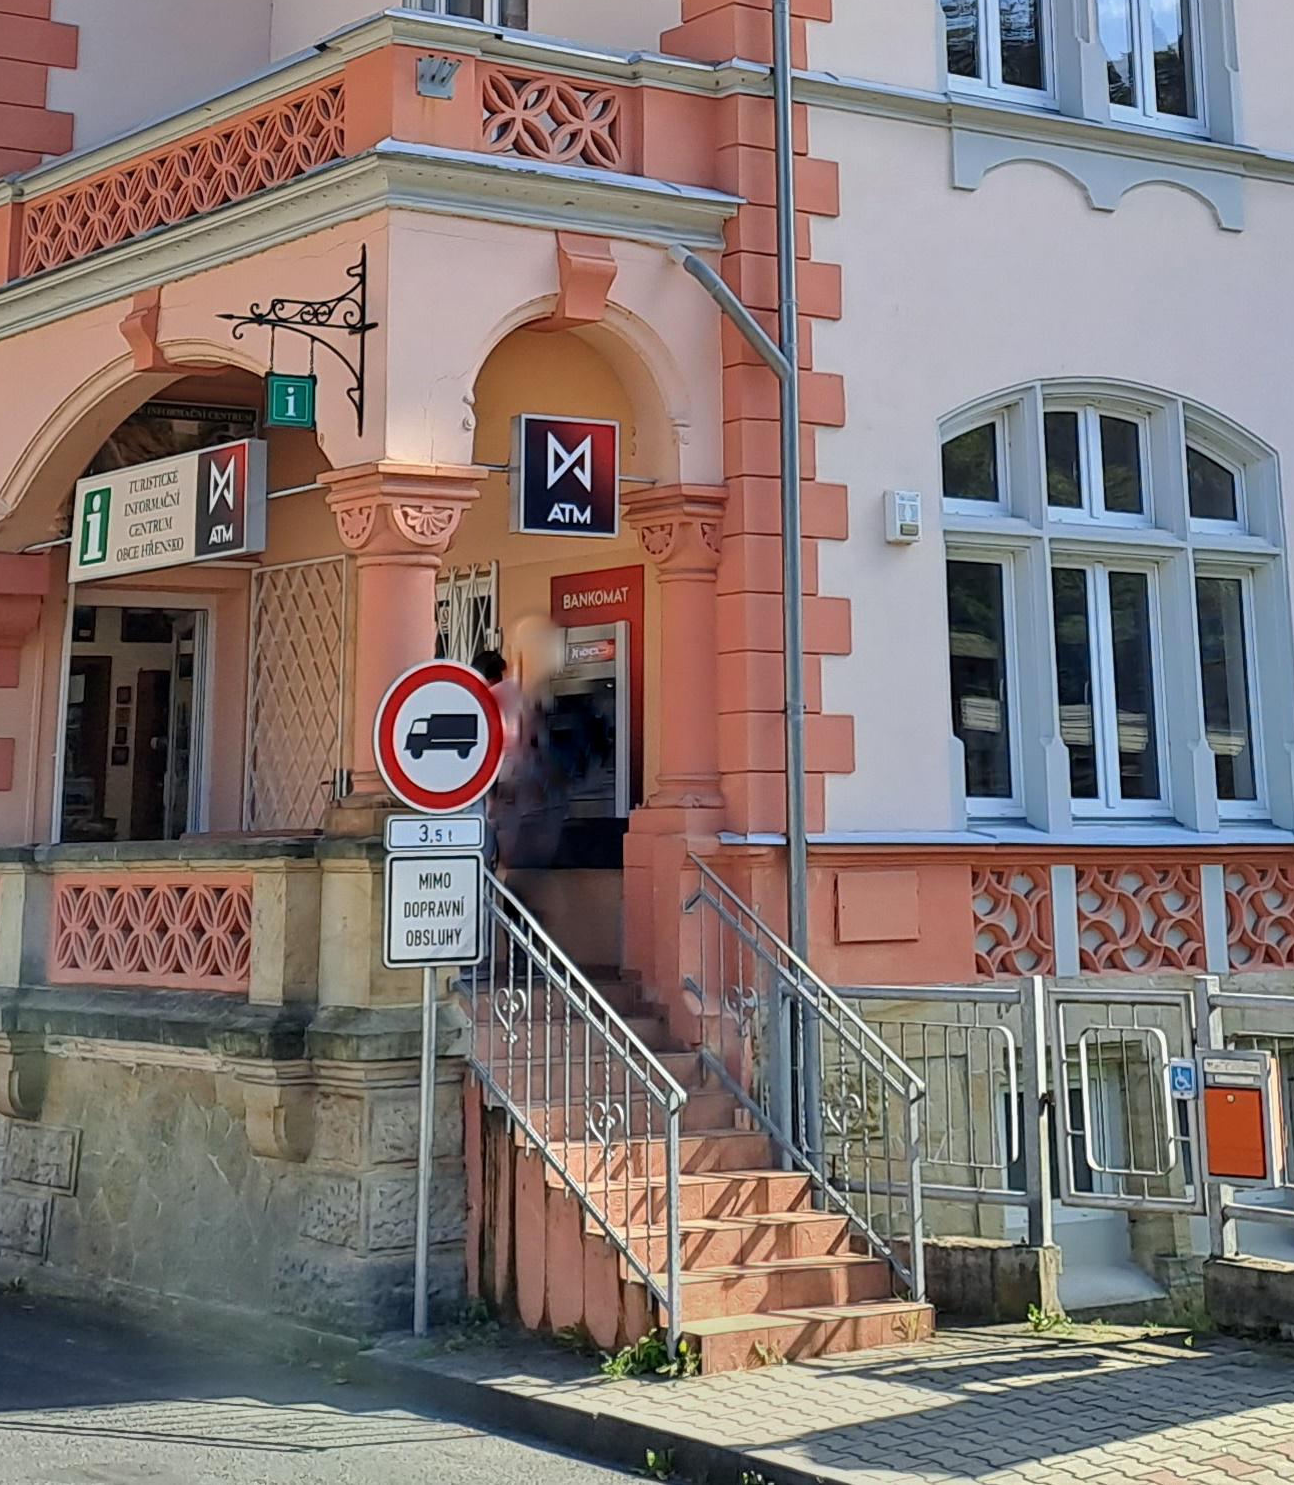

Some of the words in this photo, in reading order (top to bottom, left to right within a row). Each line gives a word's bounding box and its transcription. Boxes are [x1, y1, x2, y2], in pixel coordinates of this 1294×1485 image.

[284, 386, 297, 417] i
[128, 467, 179, 494] TURISTICKÉ
[124, 489, 181, 516] INFORMAČNÍ
[547, 502, 591, 524] ATM
[82, 494, 103, 562] i
[128, 517, 173, 537] CENTRUM
[208, 523, 234, 545] ATM
[116, 544, 140, 562] OBCE
[140, 537, 185, 557] HŘENSKO
[562, 587, 629, 609] BANKOMAT
[418, 872, 452, 890] MIMO
[403, 895, 466, 919] DOPRAVNÍ
[405, 927, 463, 947] OBSLUHY
